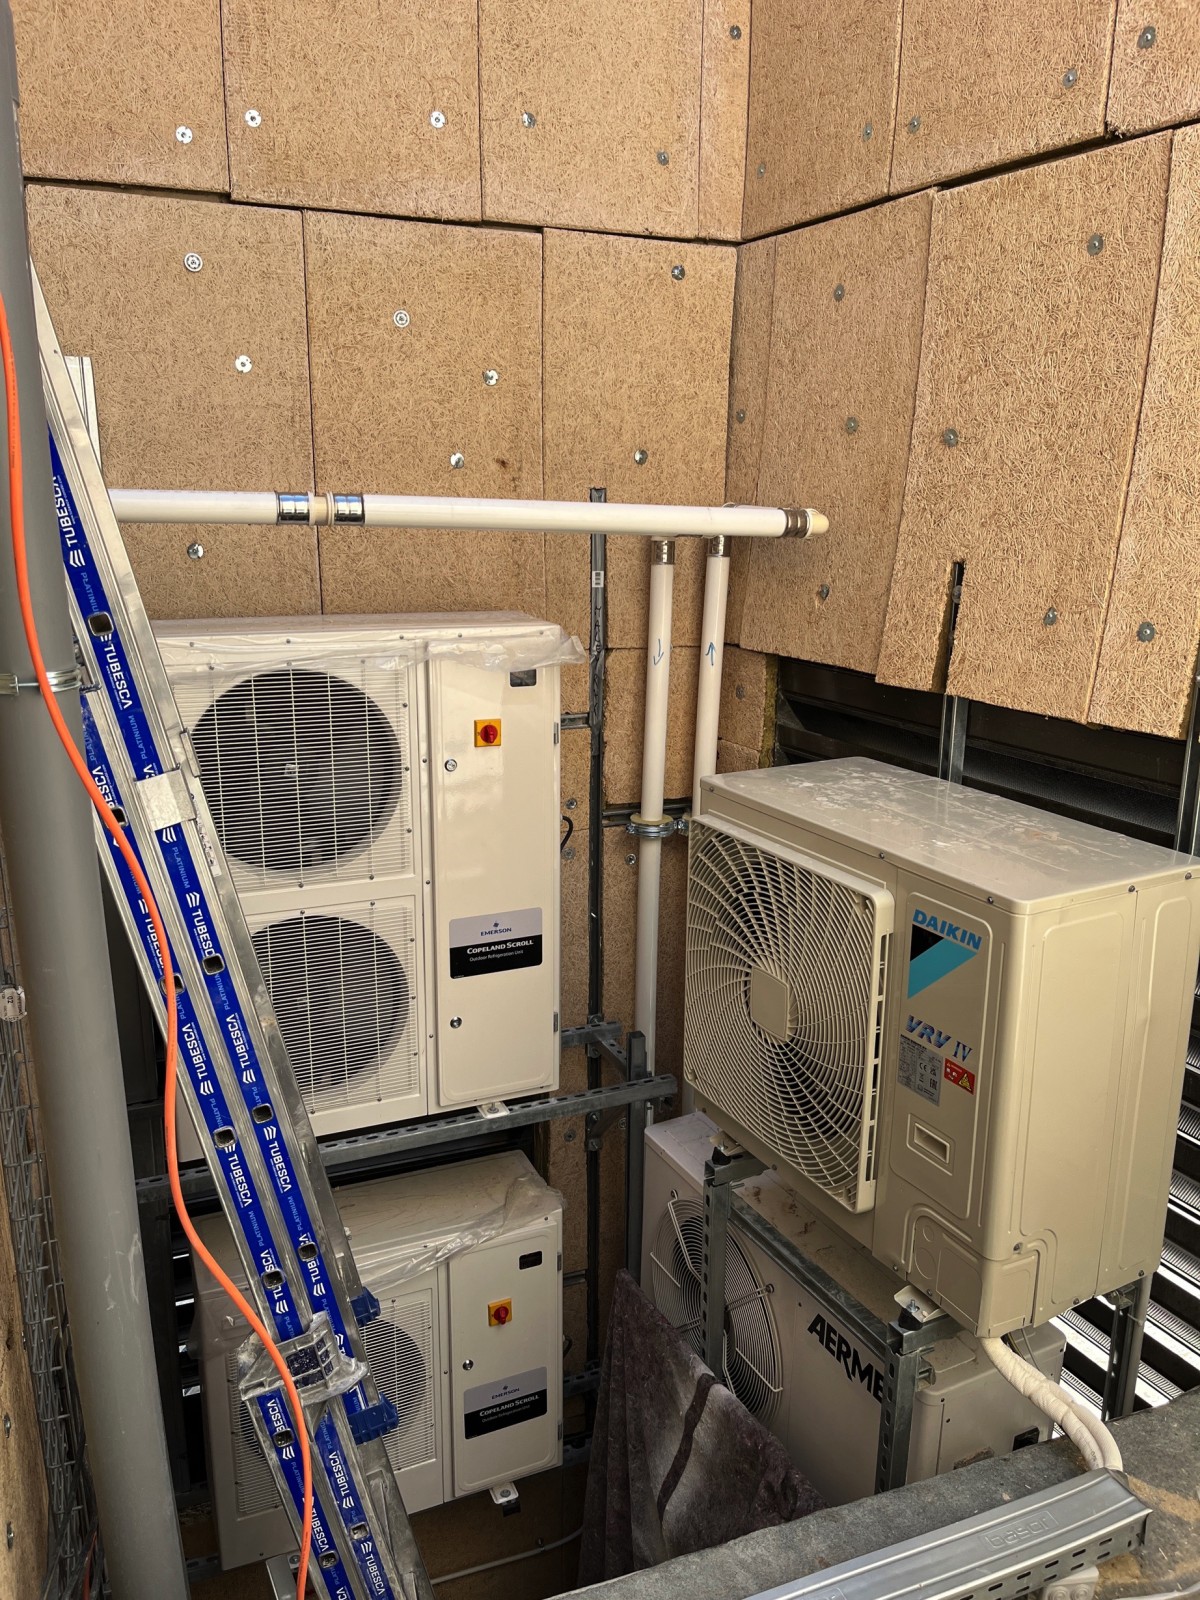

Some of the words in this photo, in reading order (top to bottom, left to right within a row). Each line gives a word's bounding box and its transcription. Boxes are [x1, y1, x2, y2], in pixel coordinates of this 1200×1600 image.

[81, 572, 99, 614] PLATINIU
[104, 644, 132, 709] TUBESCA
[128, 715, 147, 760] PLATINIUM
[172, 847, 190, 889] PLATINIUM
[192, 909, 215, 957] TUBESC
[480, 927, 512, 937] EMERSON
[912, 908, 982, 950] DAIKIN
[182, 1023, 208, 1080] TUBESCA
[226, 1014, 250, 1069] TUBESCA
[905, 1014, 952, 1049] VRV
[952, 1040, 973, 1062] IV
[228, 1154, 253, 1207] TUBESCA
[269, 1141, 292, 1192] TUBESCA
[248, 1211, 264, 1247] PLATINIUM
[287, 1196, 303, 1231] PLATINIUM
[807, 1313, 884, 1404] AERME
[491, 1387, 520, 1400] EMERSON
[329, 1452, 350, 1496] TUBESCA
[365, 1554, 386, 1595] TUBESCA
